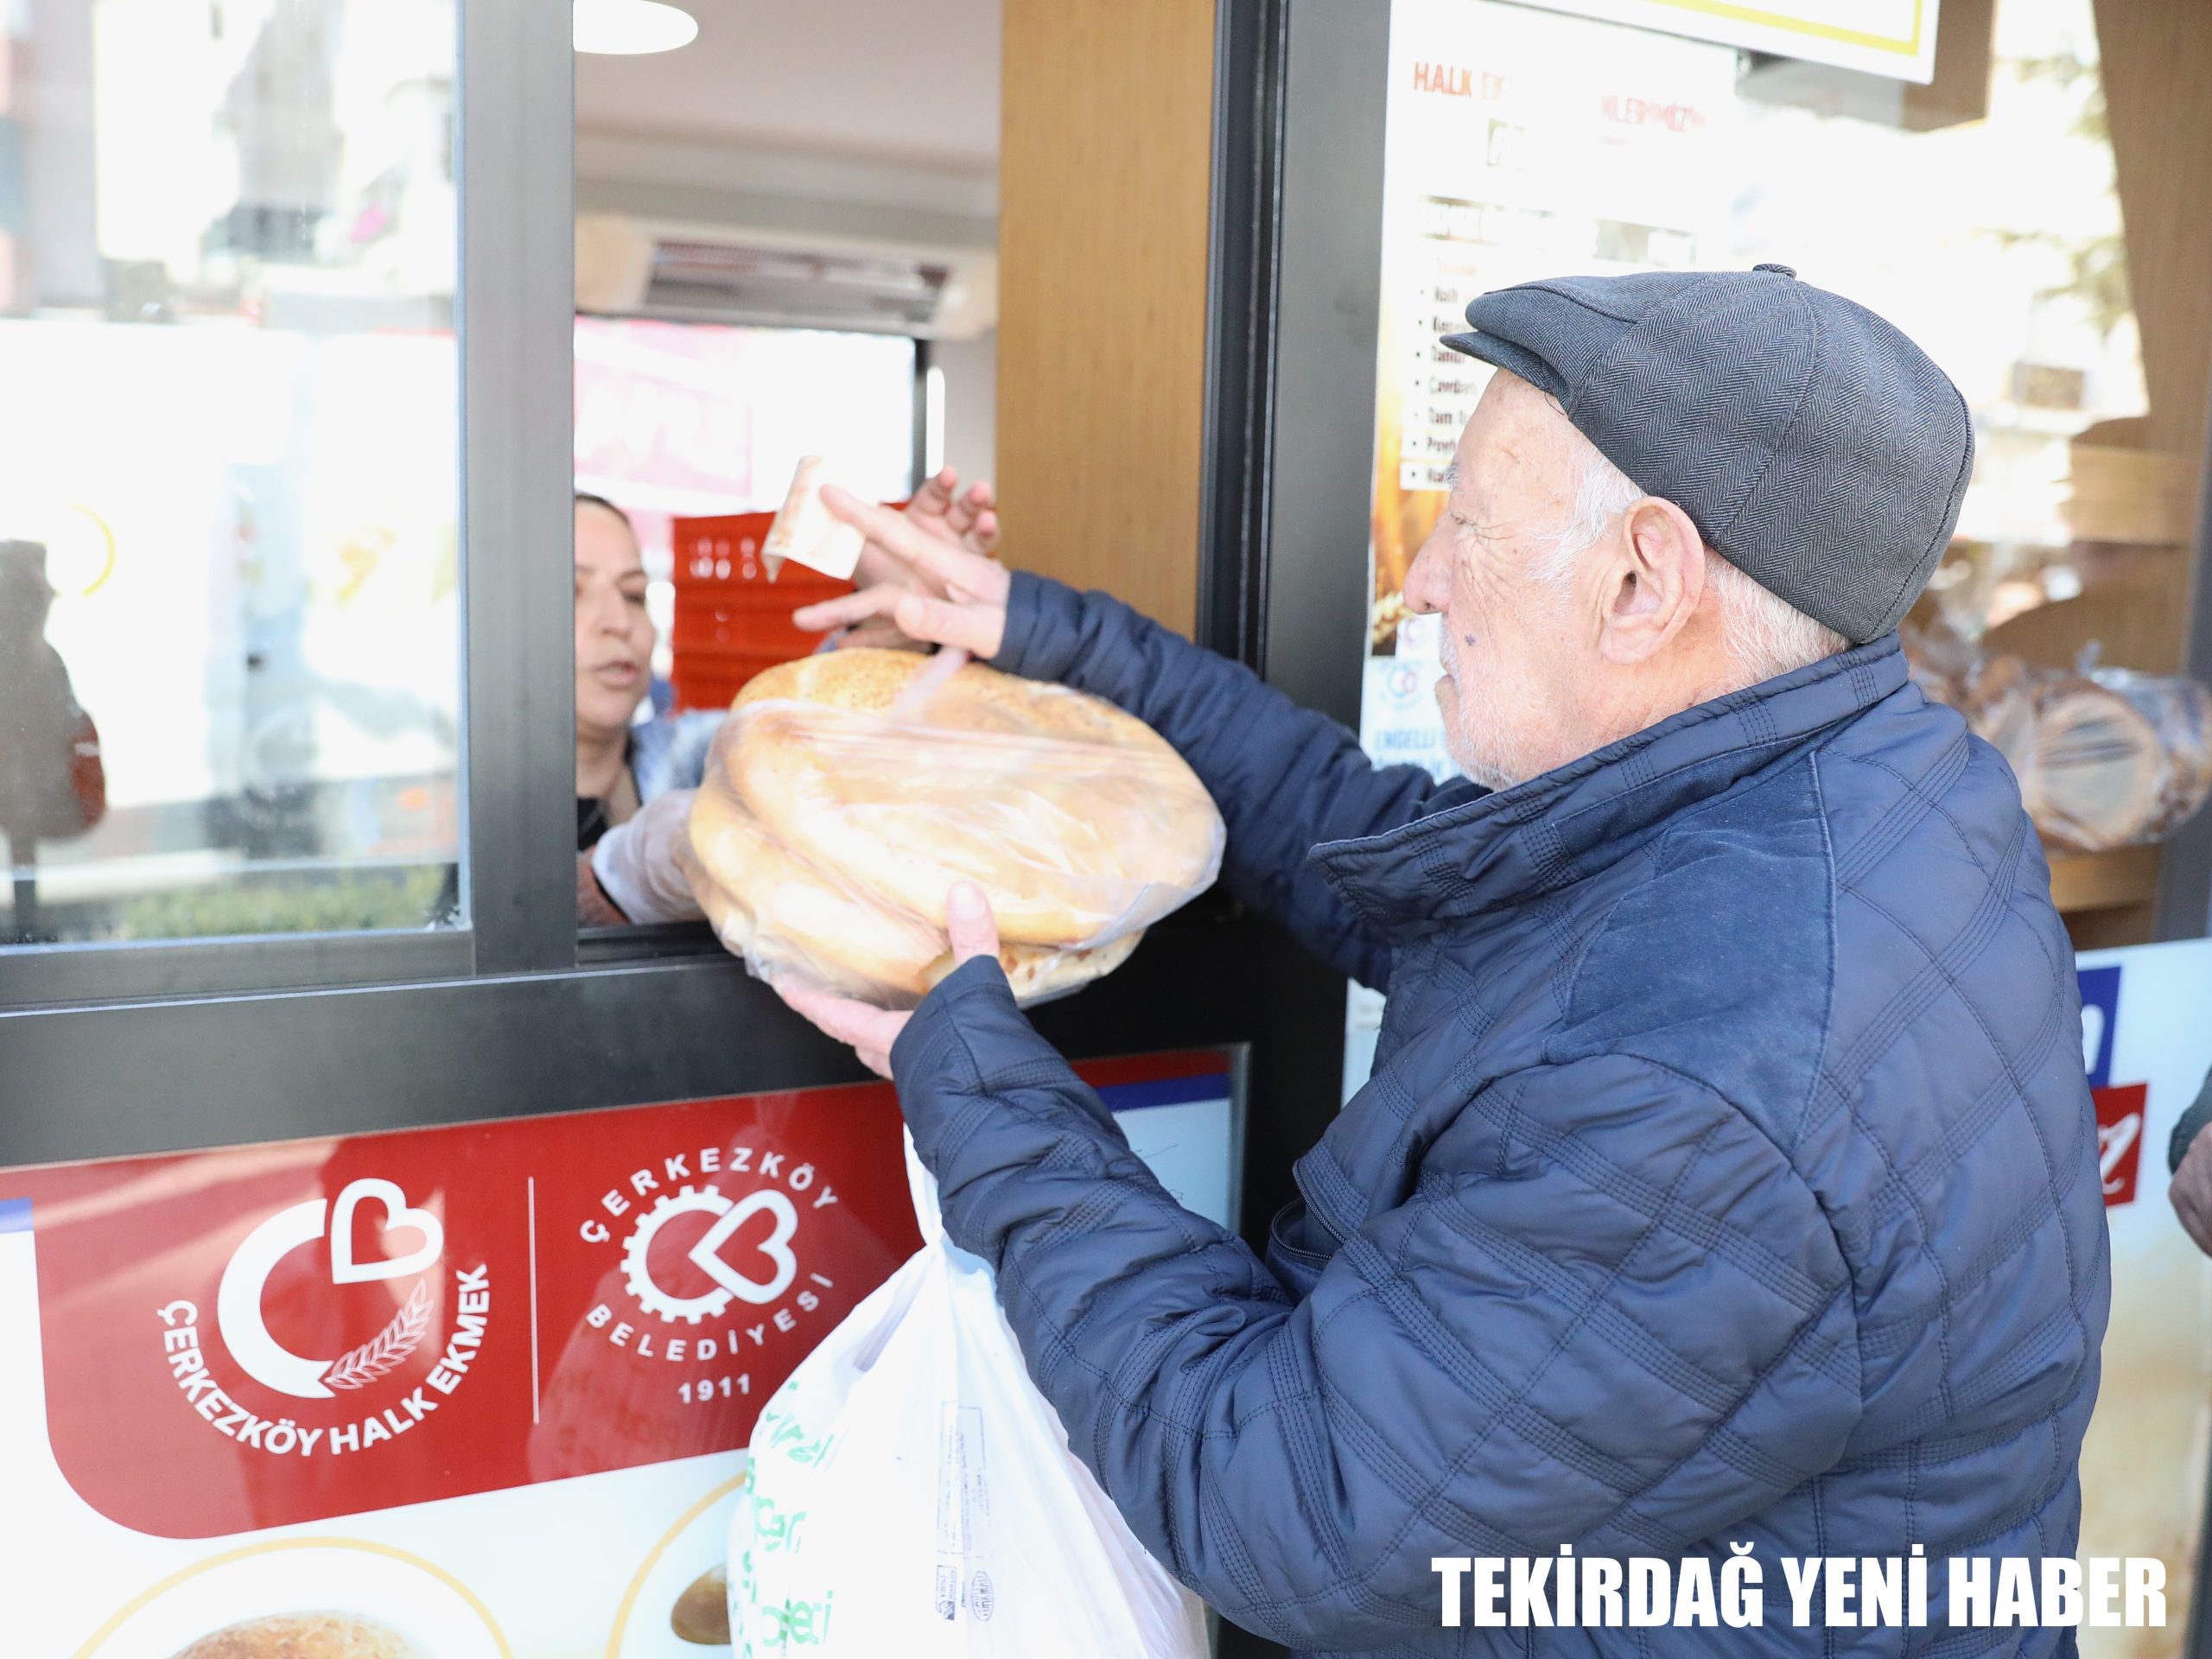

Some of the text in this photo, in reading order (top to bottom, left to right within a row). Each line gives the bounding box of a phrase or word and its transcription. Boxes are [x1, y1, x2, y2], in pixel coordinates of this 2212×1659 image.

[1414, 61, 1472, 98] HALK
[580, 1147, 838, 1243] ÇERKEZKÖY
[156, 1263, 490, 1457] ÇERKEZKÖY HALK EKMEK
[678, 1373, 750, 1404] 1911
